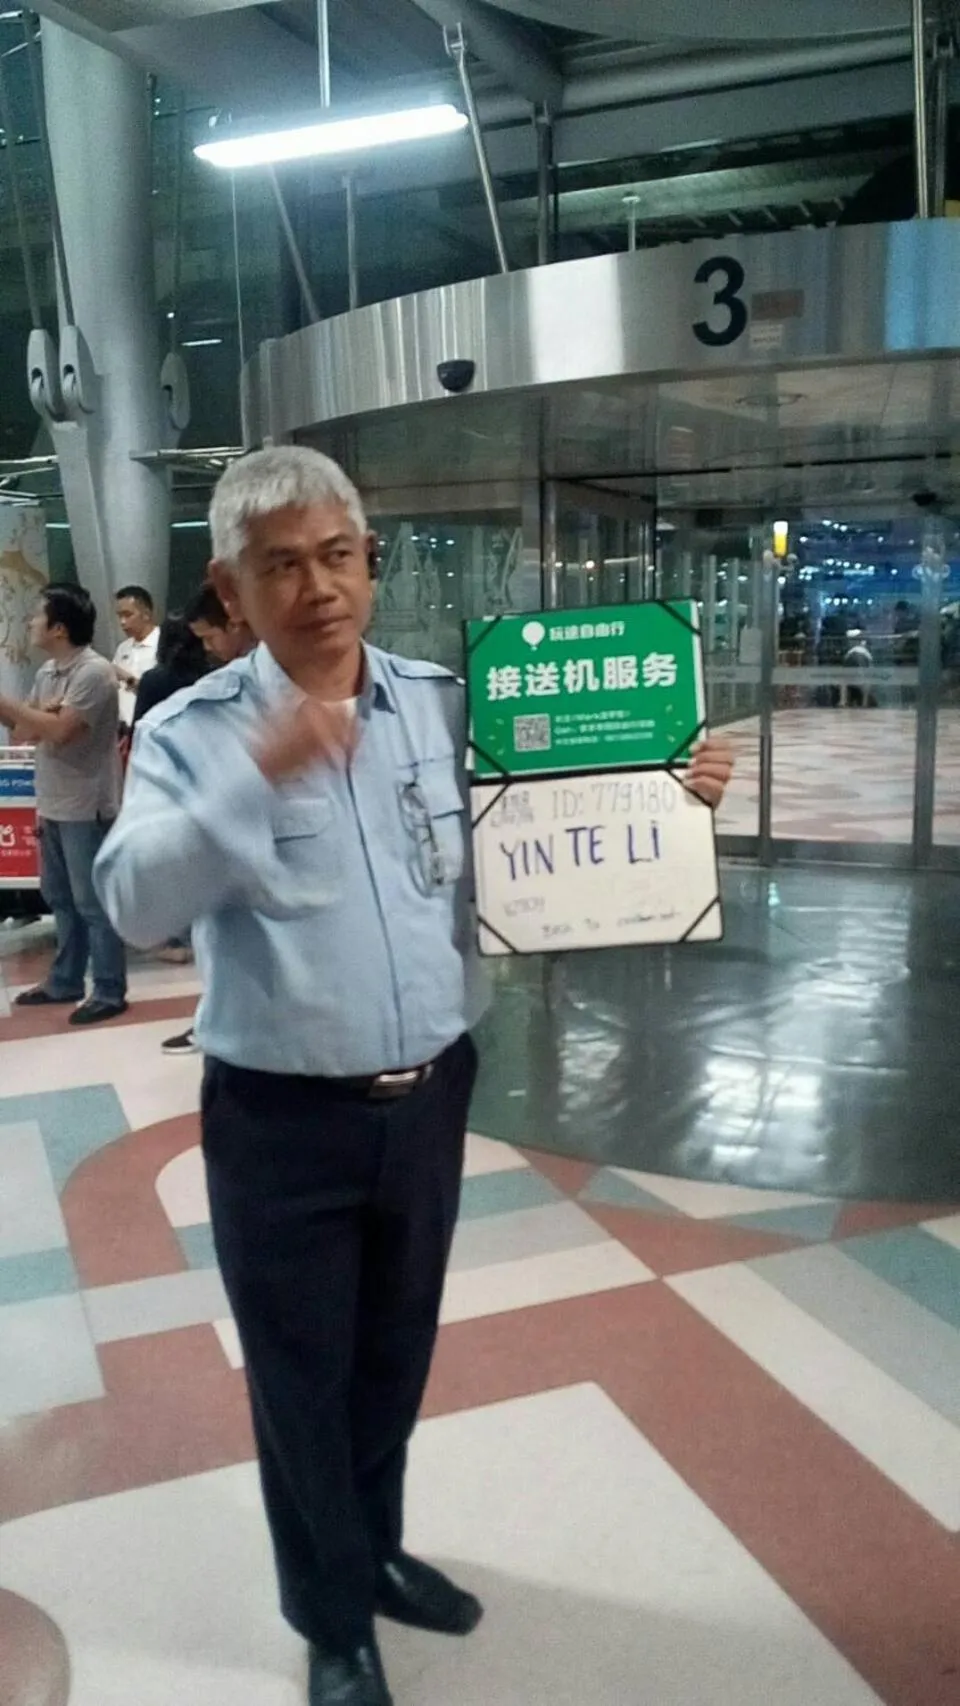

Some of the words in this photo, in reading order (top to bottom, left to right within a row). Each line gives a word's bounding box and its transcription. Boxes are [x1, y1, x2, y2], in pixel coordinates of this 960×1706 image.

[692, 256, 747, 347] 3
[487, 652, 677, 701] 接送机服务
[552, 788, 583, 819] ID:
[500, 834, 555, 881] YIN
[566, 823, 606, 867] TE
